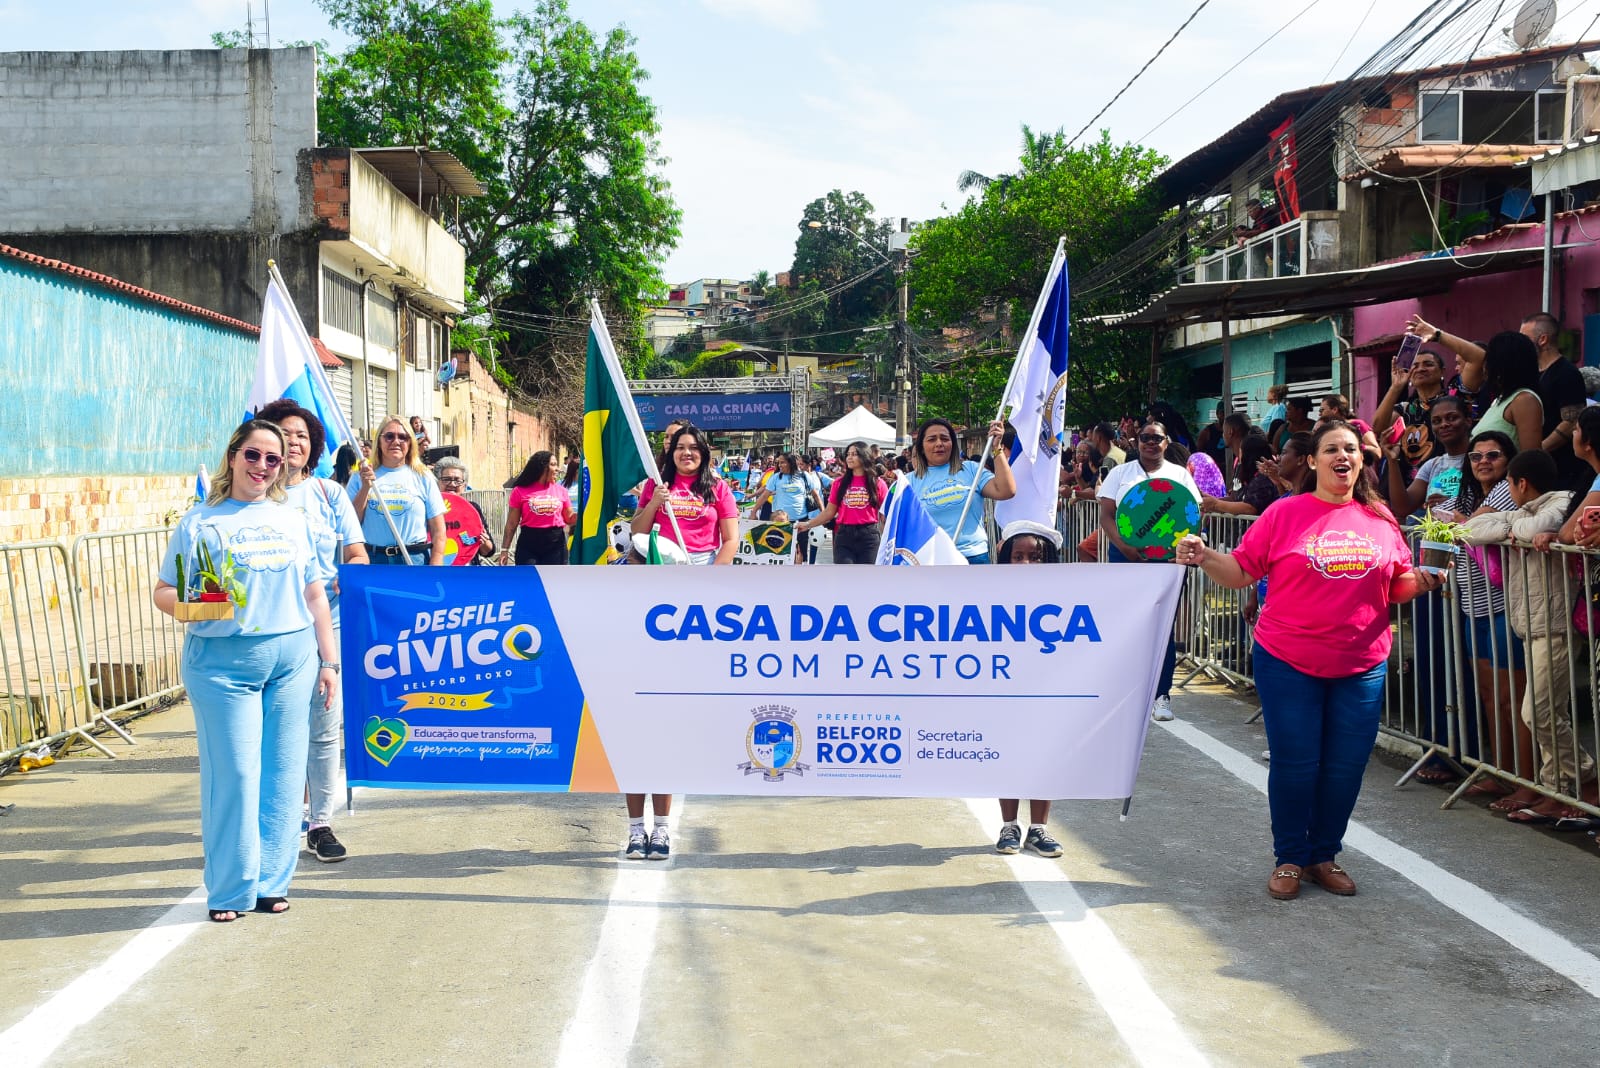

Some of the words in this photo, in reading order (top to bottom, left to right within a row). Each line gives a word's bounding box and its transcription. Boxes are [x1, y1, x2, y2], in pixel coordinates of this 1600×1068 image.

[664, 405, 698, 415] CASA
[702, 404, 720, 414] DA
[723, 403, 780, 415] CRIANÇA
[1136, 497, 1176, 538] IGUALDADE
[1318, 539, 1354, 548] Educação
[1317, 554, 1357, 564] Esperança
[414, 600, 515, 634] DESFILE
[644, 603, 780, 642] CASA
[789, 604, 860, 642] DA
[867, 603, 1102, 654] CRIANÇA
[364, 623, 544, 680] CÍVICO
[730, 652, 820, 678] BOM
[845, 653, 1012, 680] PASTOR
[403, 675, 467, 691] BELFORD
[475, 669, 513, 682] ROXO
[428, 695, 468, 708] 2026
[817, 713, 901, 721] PREFEITURA
[414, 728, 459, 742] Educação
[460, 731, 479, 742] que
[480, 729, 537, 742] transforma,
[817, 726, 901, 741] BELFORD
[917, 729, 983, 742] Secretaria
[412, 745, 474, 760] esperança
[479, 746, 500, 761] que
[817, 742, 902, 764] ROXO
[917, 747, 934, 760] de
[937, 747, 1000, 763] Educação
